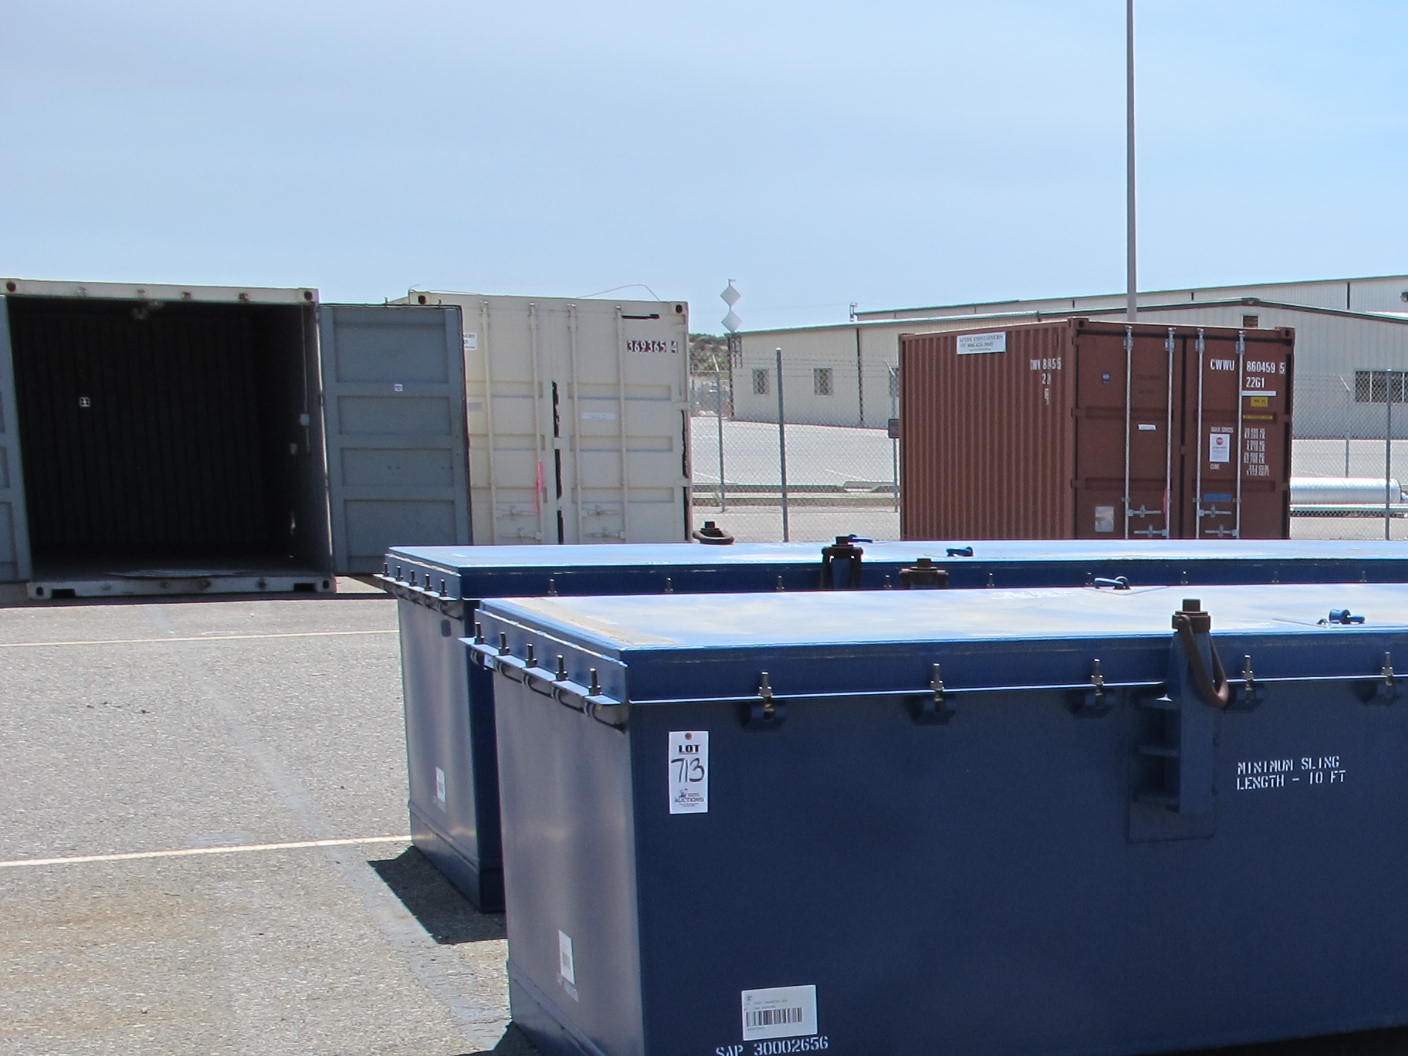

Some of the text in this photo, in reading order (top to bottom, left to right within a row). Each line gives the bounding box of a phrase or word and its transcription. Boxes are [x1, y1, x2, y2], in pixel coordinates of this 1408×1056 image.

[626, 340, 666, 353] 369365
[1209, 359, 1287, 375] CWWU 860459 5
[1246, 377, 1265, 388] 22G1
[678, 744, 700, 754] LOT
[670, 757, 706, 784] 713
[1237, 755, 1340, 776] MINIMUM SLING
[1236, 774, 1285, 791] LENGTH
[1309, 771, 1323, 785] 10
[1330, 769, 1346, 783] FT
[753, 1035, 829, 1056] 30002656
